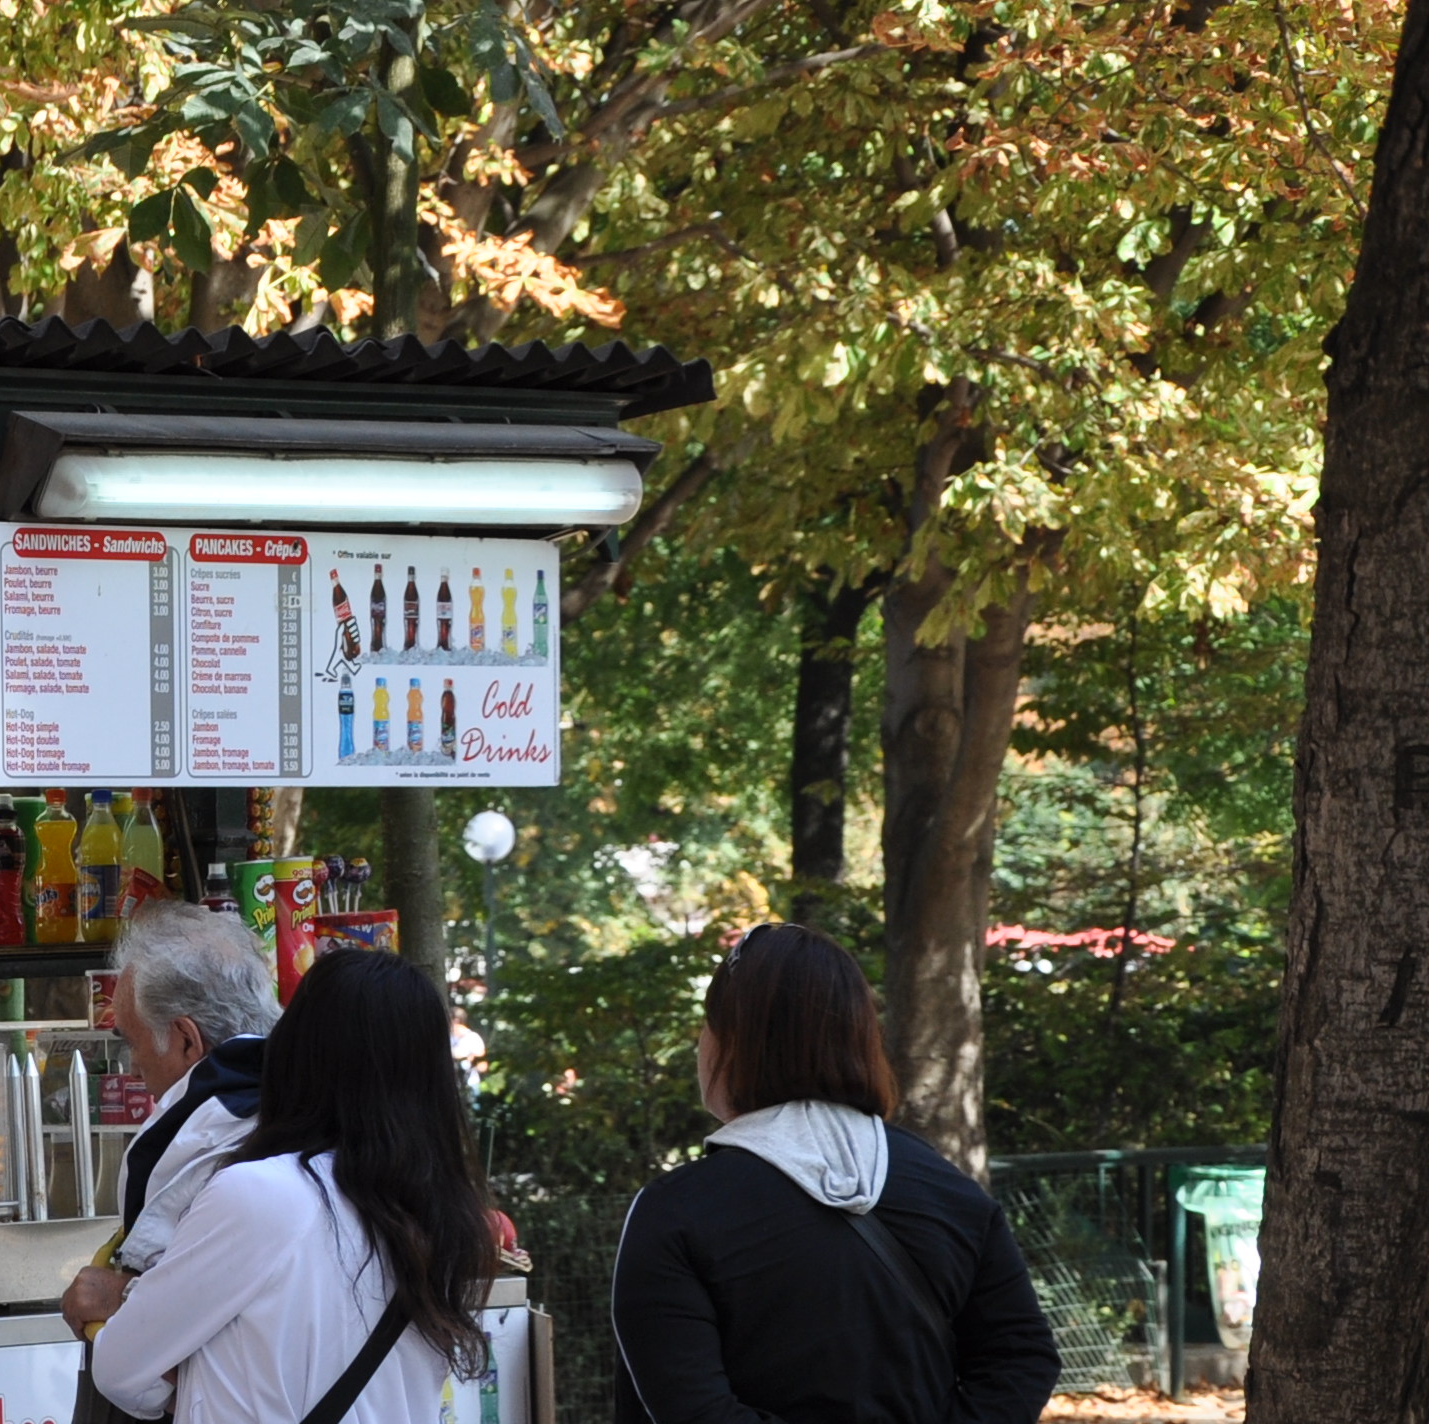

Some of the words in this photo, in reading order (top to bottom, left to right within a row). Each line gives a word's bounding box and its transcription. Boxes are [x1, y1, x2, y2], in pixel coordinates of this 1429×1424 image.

[15, 533, 91, 552] SANDWICHES
[103, 536, 165, 554] Sandwichs
[195, 538, 253, 556] PANCAKES
[29, 579, 52, 588] beurre
[191, 582, 210, 591] Sucre
[192, 658, 220, 669] Chocolat
[482, 679, 533, 719] Cold
[6, 709, 34, 720] Hot-Dog
[6, 722, 35, 733] Hot-Dog
[37, 722, 59, 733] simple
[192, 722, 218, 733] Jambon
[6, 735, 35, 746] Hot-Dog
[37, 735, 59, 745] double
[192, 735, 221, 746] Fromage
[461, 727, 552, 763] Drinks
